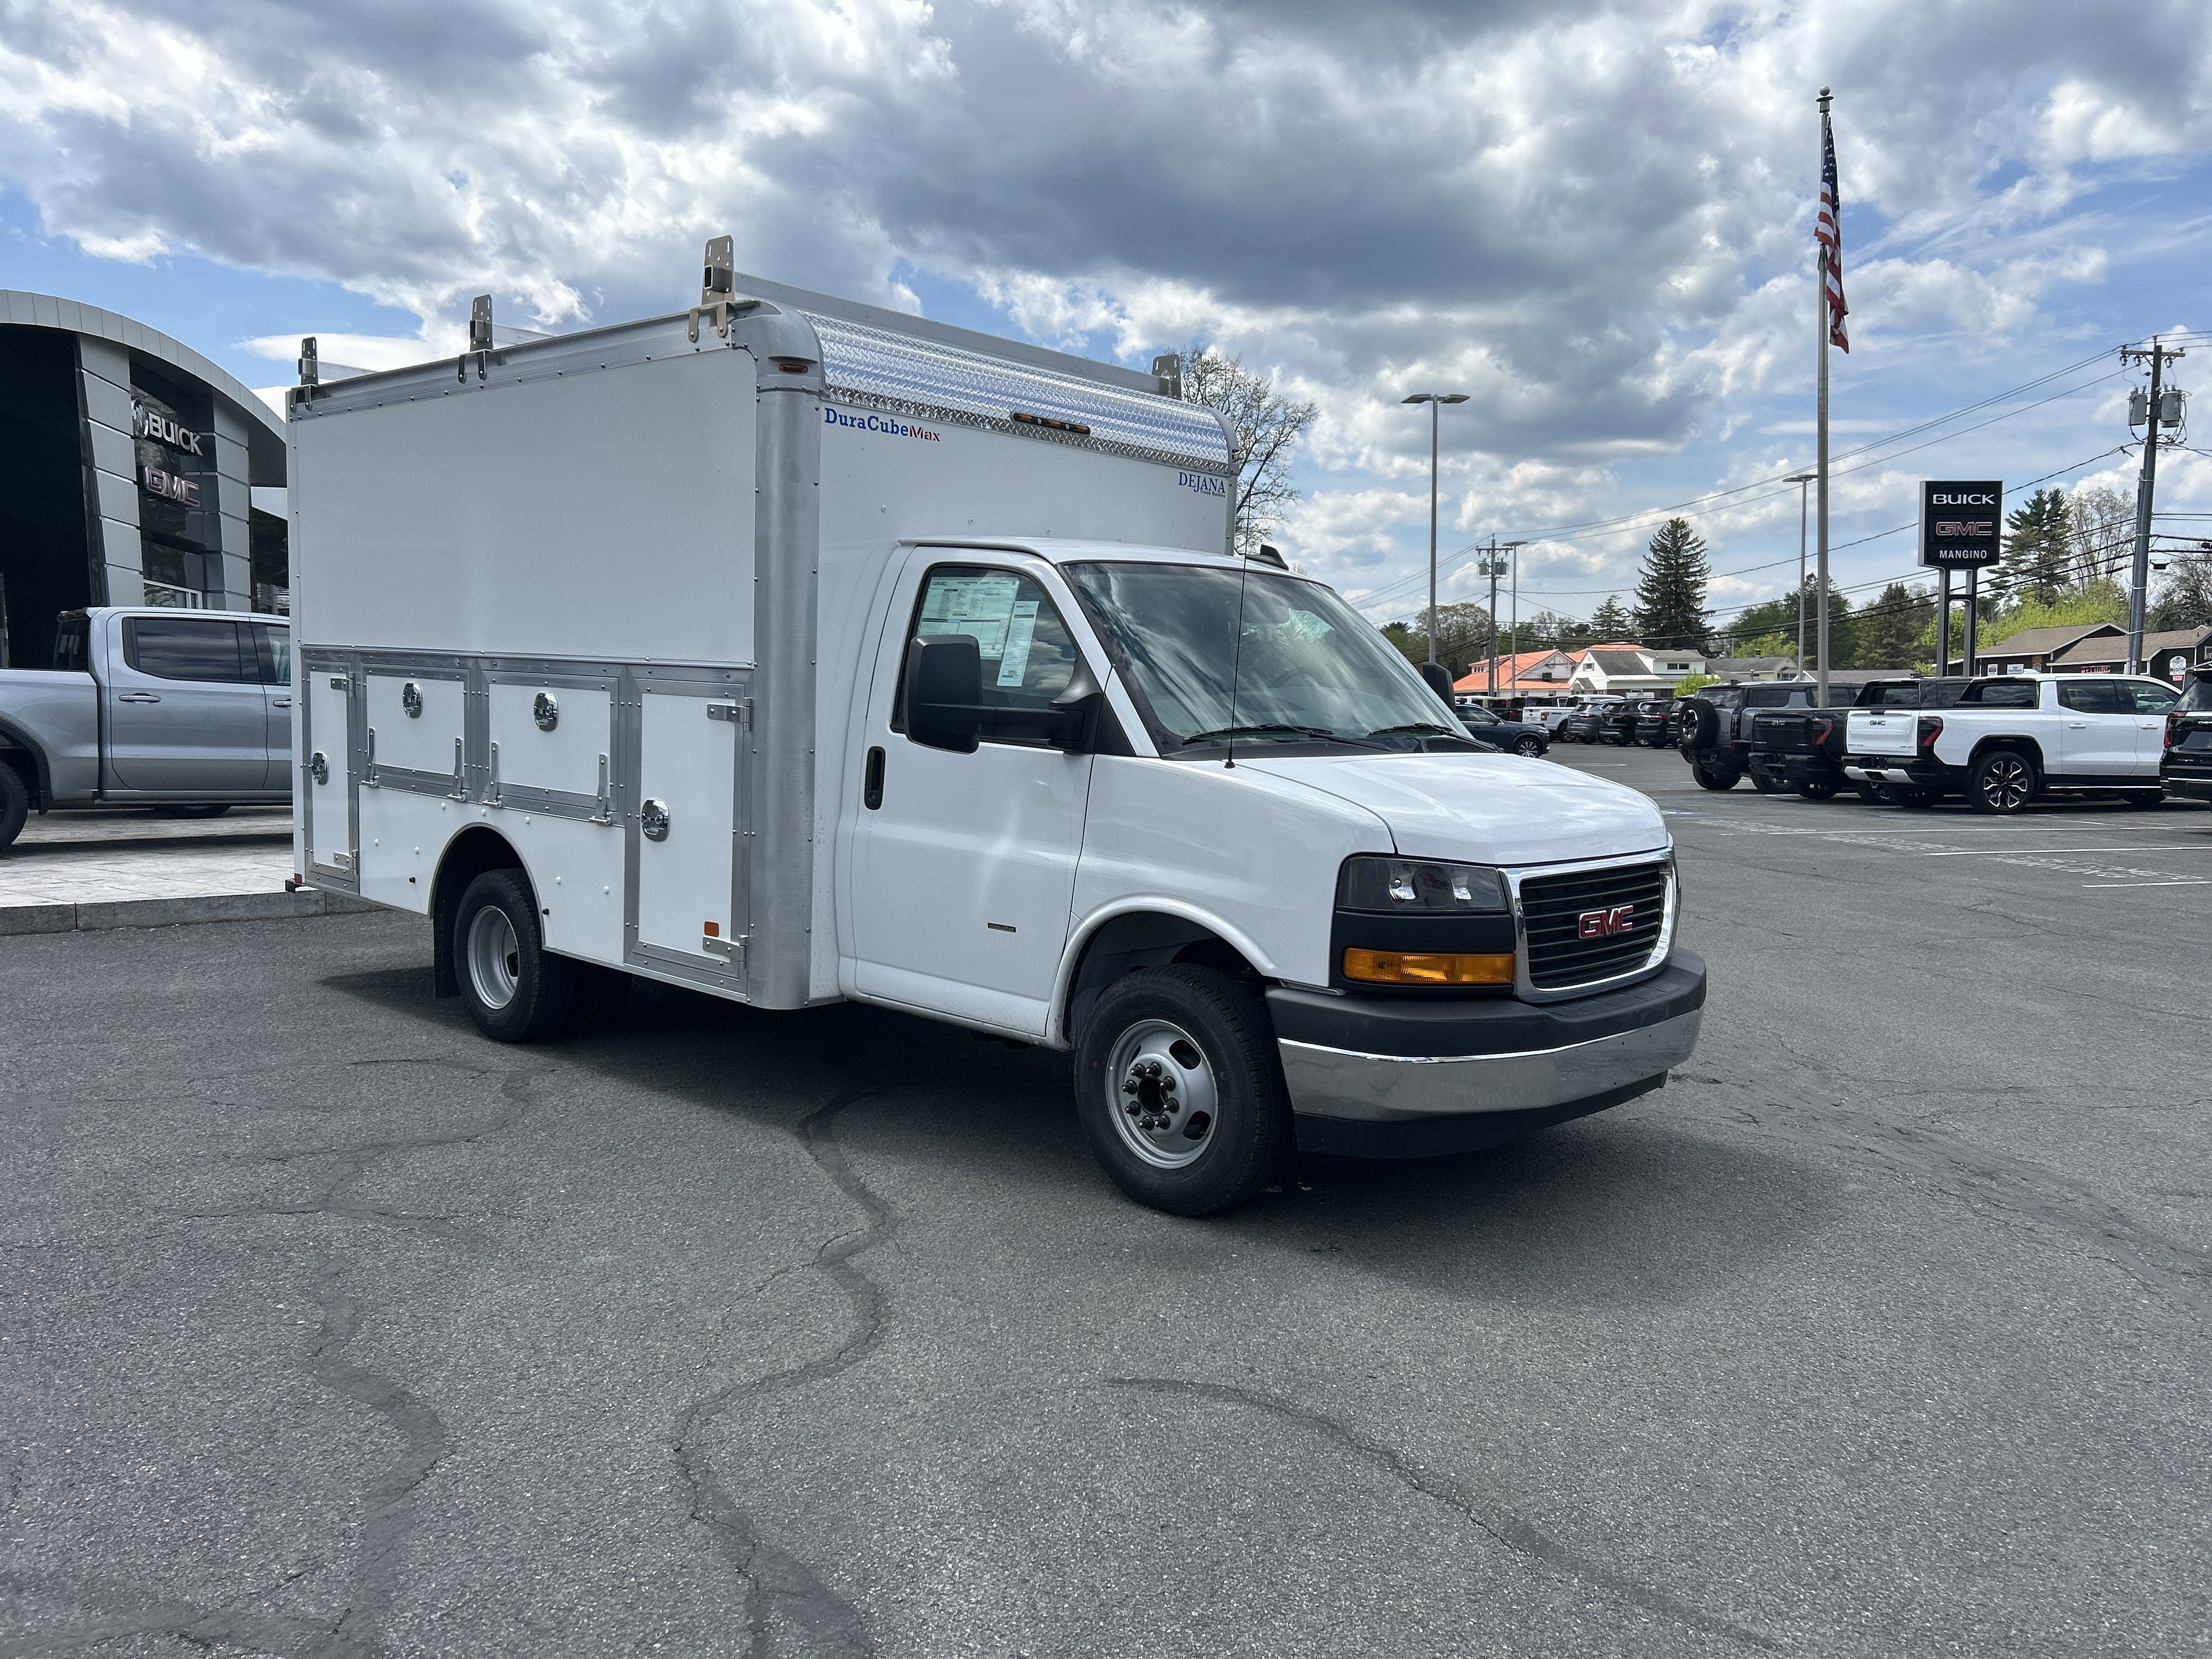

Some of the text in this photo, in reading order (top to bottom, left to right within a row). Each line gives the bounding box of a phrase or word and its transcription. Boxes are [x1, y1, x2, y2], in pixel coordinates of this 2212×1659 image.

[149, 413, 203, 456] BUICK
[825, 408, 940, 442] DuraCubeMax
[145, 466, 200, 507] GMC
[1178, 472, 1226, 493] DEJANA
[1933, 494, 1995, 504] BUICK
[1936, 521, 1993, 536] GMC
[1939, 550, 1987, 559] MANGINO
[1579, 905, 1633, 939] GMC
